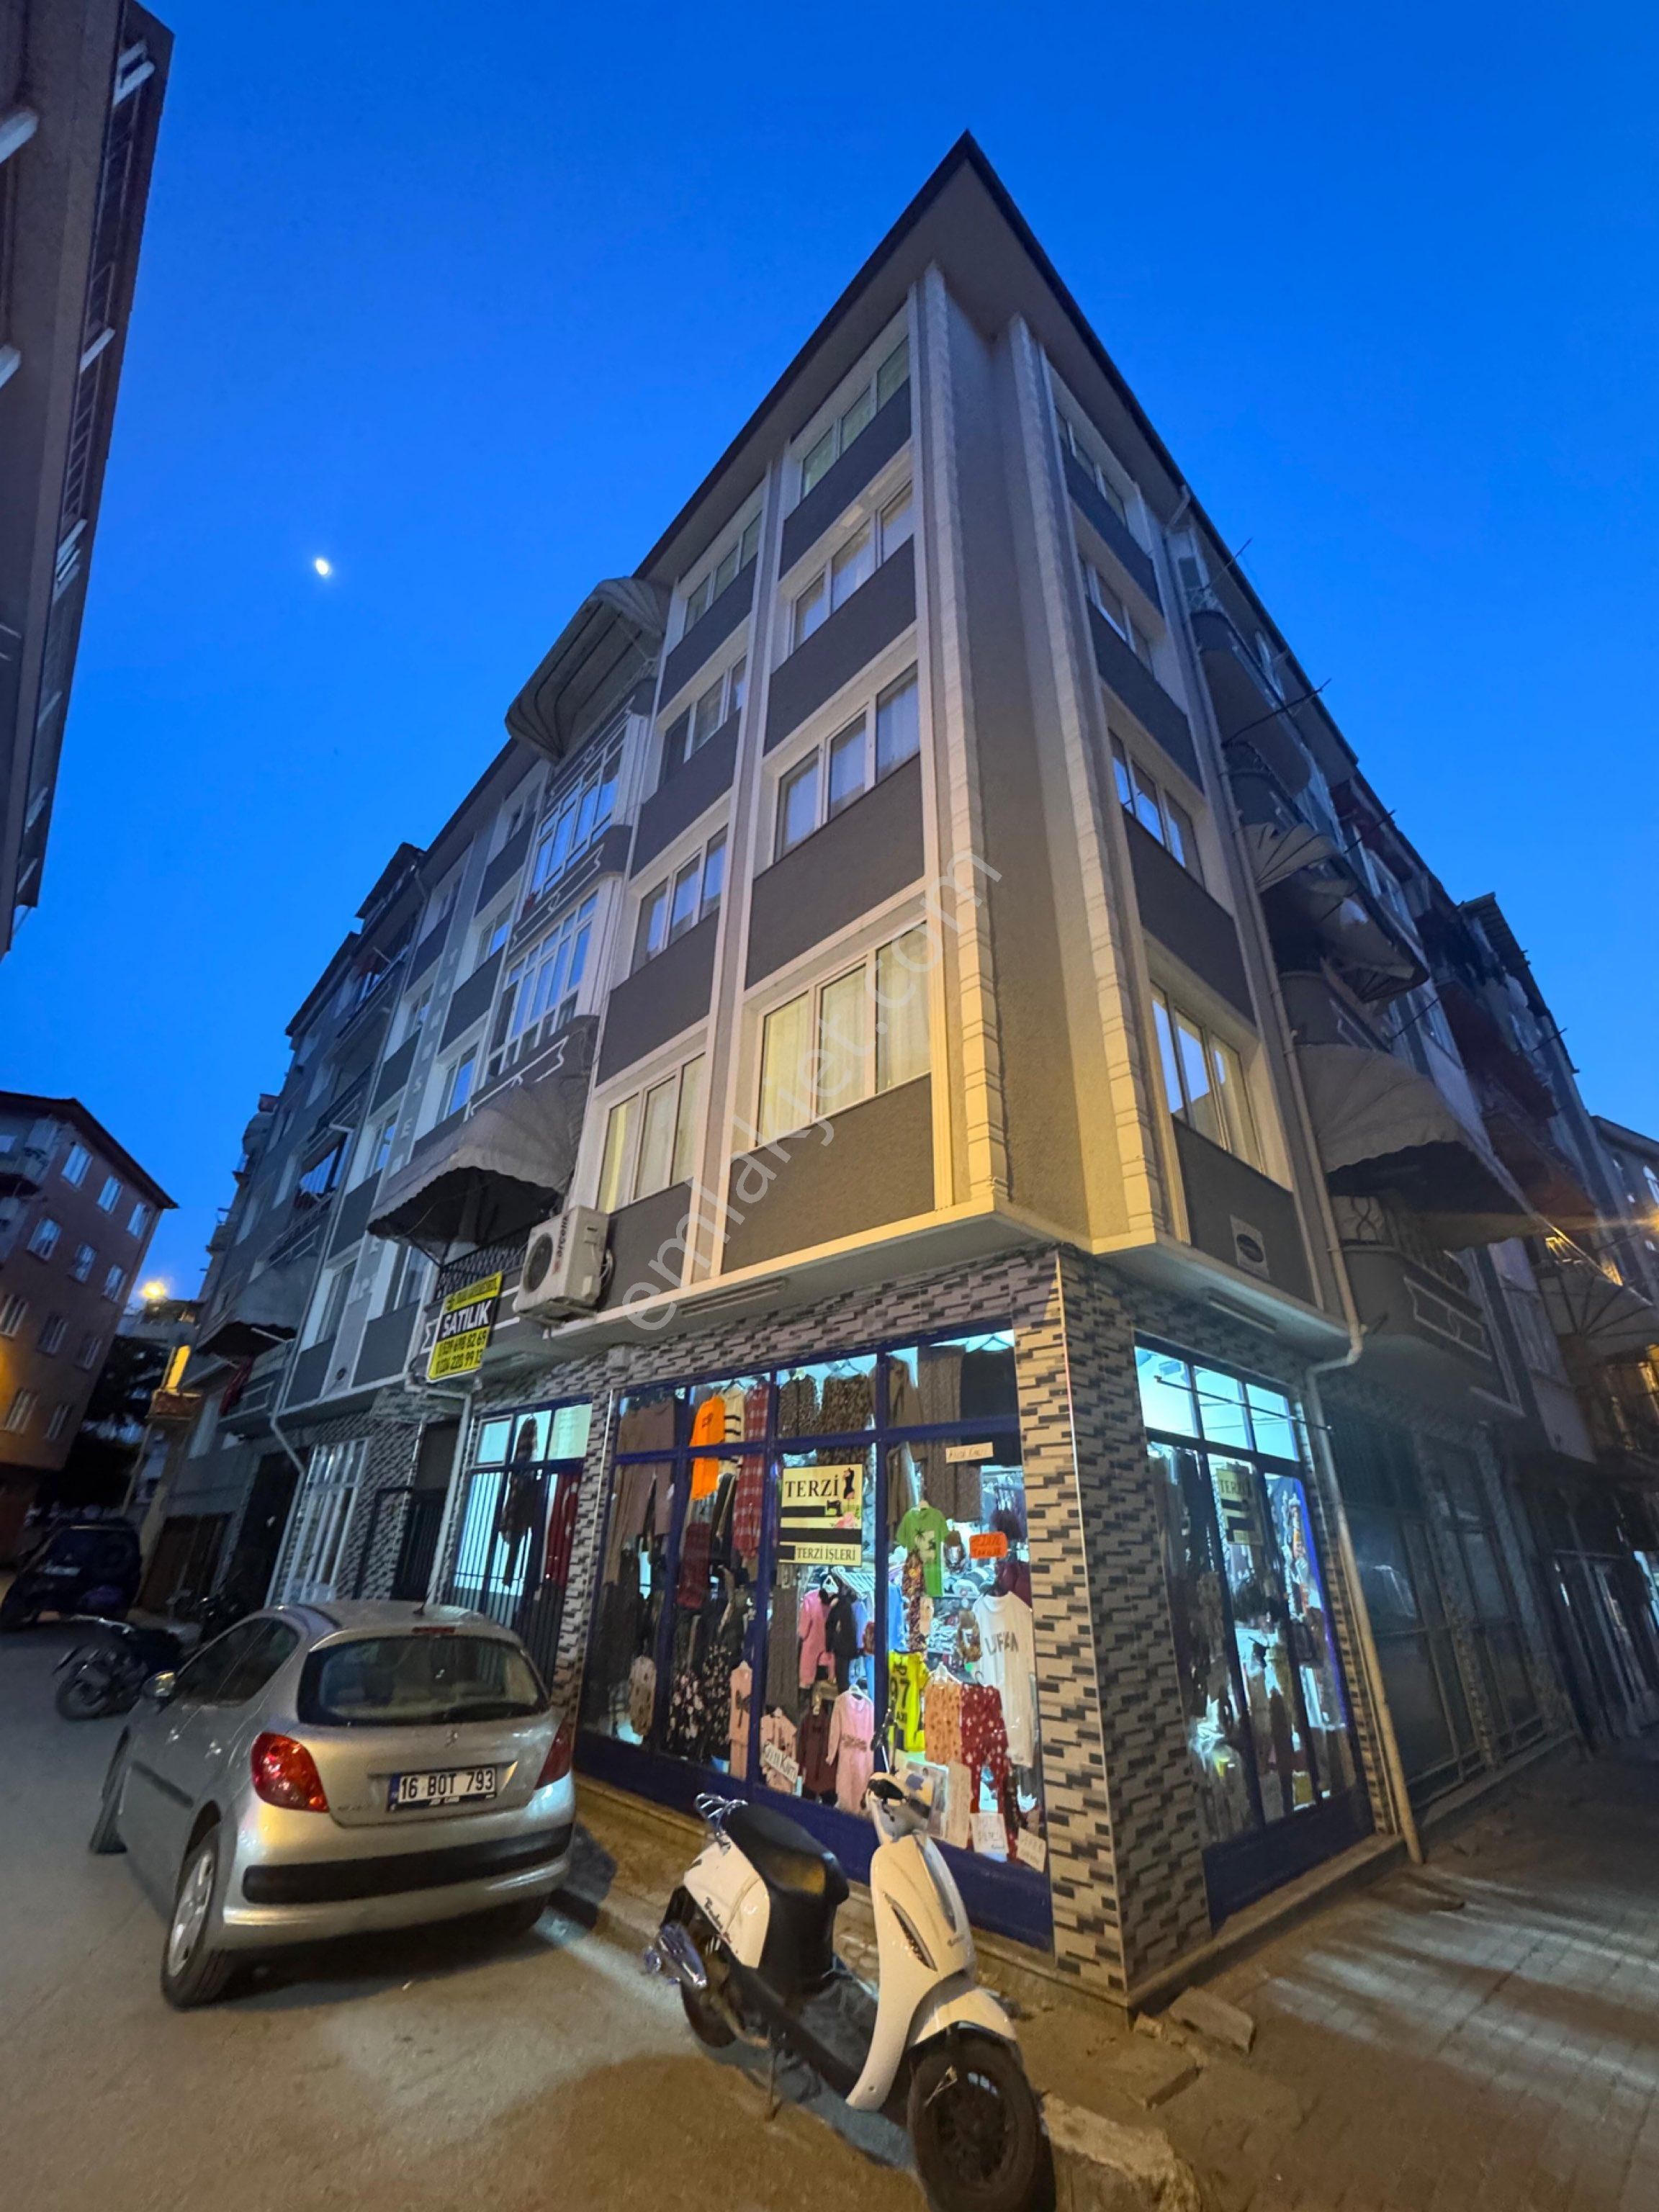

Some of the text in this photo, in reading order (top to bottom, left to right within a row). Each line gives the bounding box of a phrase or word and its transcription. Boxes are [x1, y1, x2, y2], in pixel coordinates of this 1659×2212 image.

[441, 1300, 492, 1338] SATILIK
[785, 1475, 839, 1498] TERZİ
[825, 1545, 855, 1563] İŞLERİ
[402, 1768, 493, 1799] 16 BOT 793
